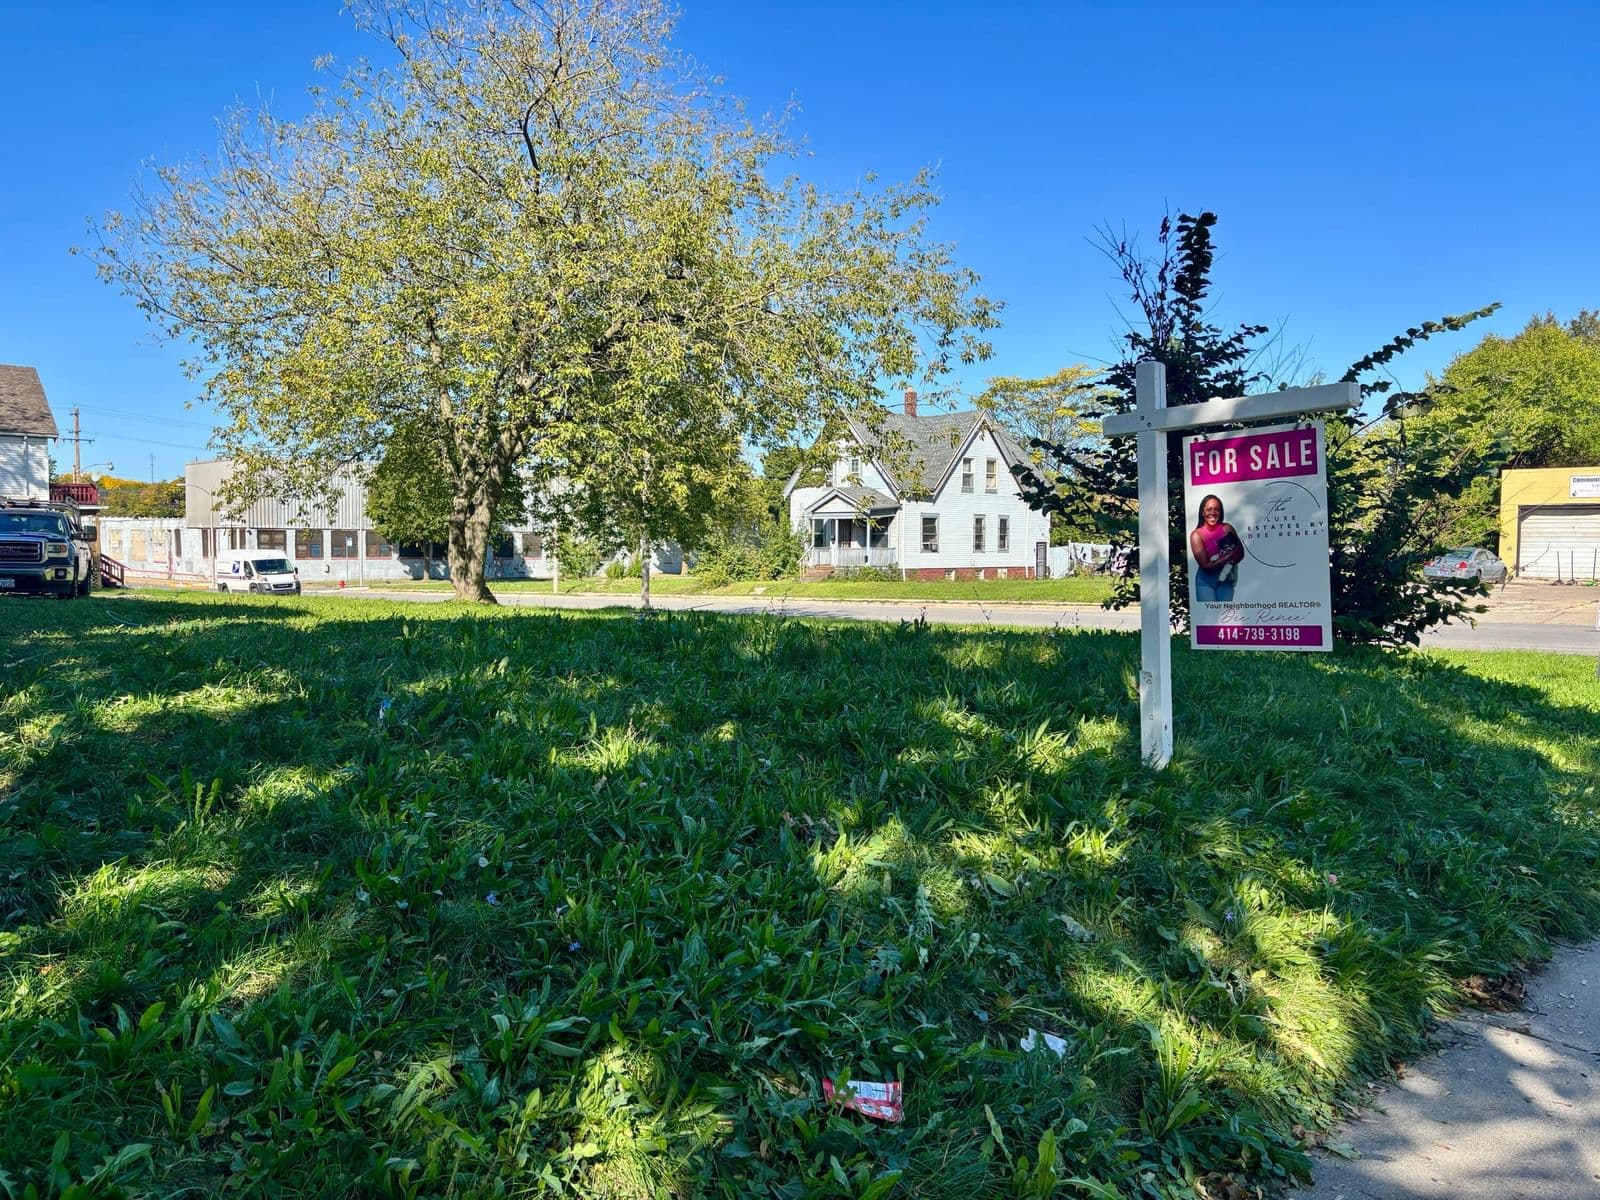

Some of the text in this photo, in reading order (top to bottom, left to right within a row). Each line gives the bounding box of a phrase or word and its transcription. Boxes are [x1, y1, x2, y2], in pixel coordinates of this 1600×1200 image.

[1194, 439, 1313, 477] FOR SALE
[1247, 523, 1300, 532] ESTATES
[1223, 602, 1277, 610] Neighborhood
[1221, 609, 1249, 624] Dee
[1218, 627, 1301, 641] 414-739-3198
